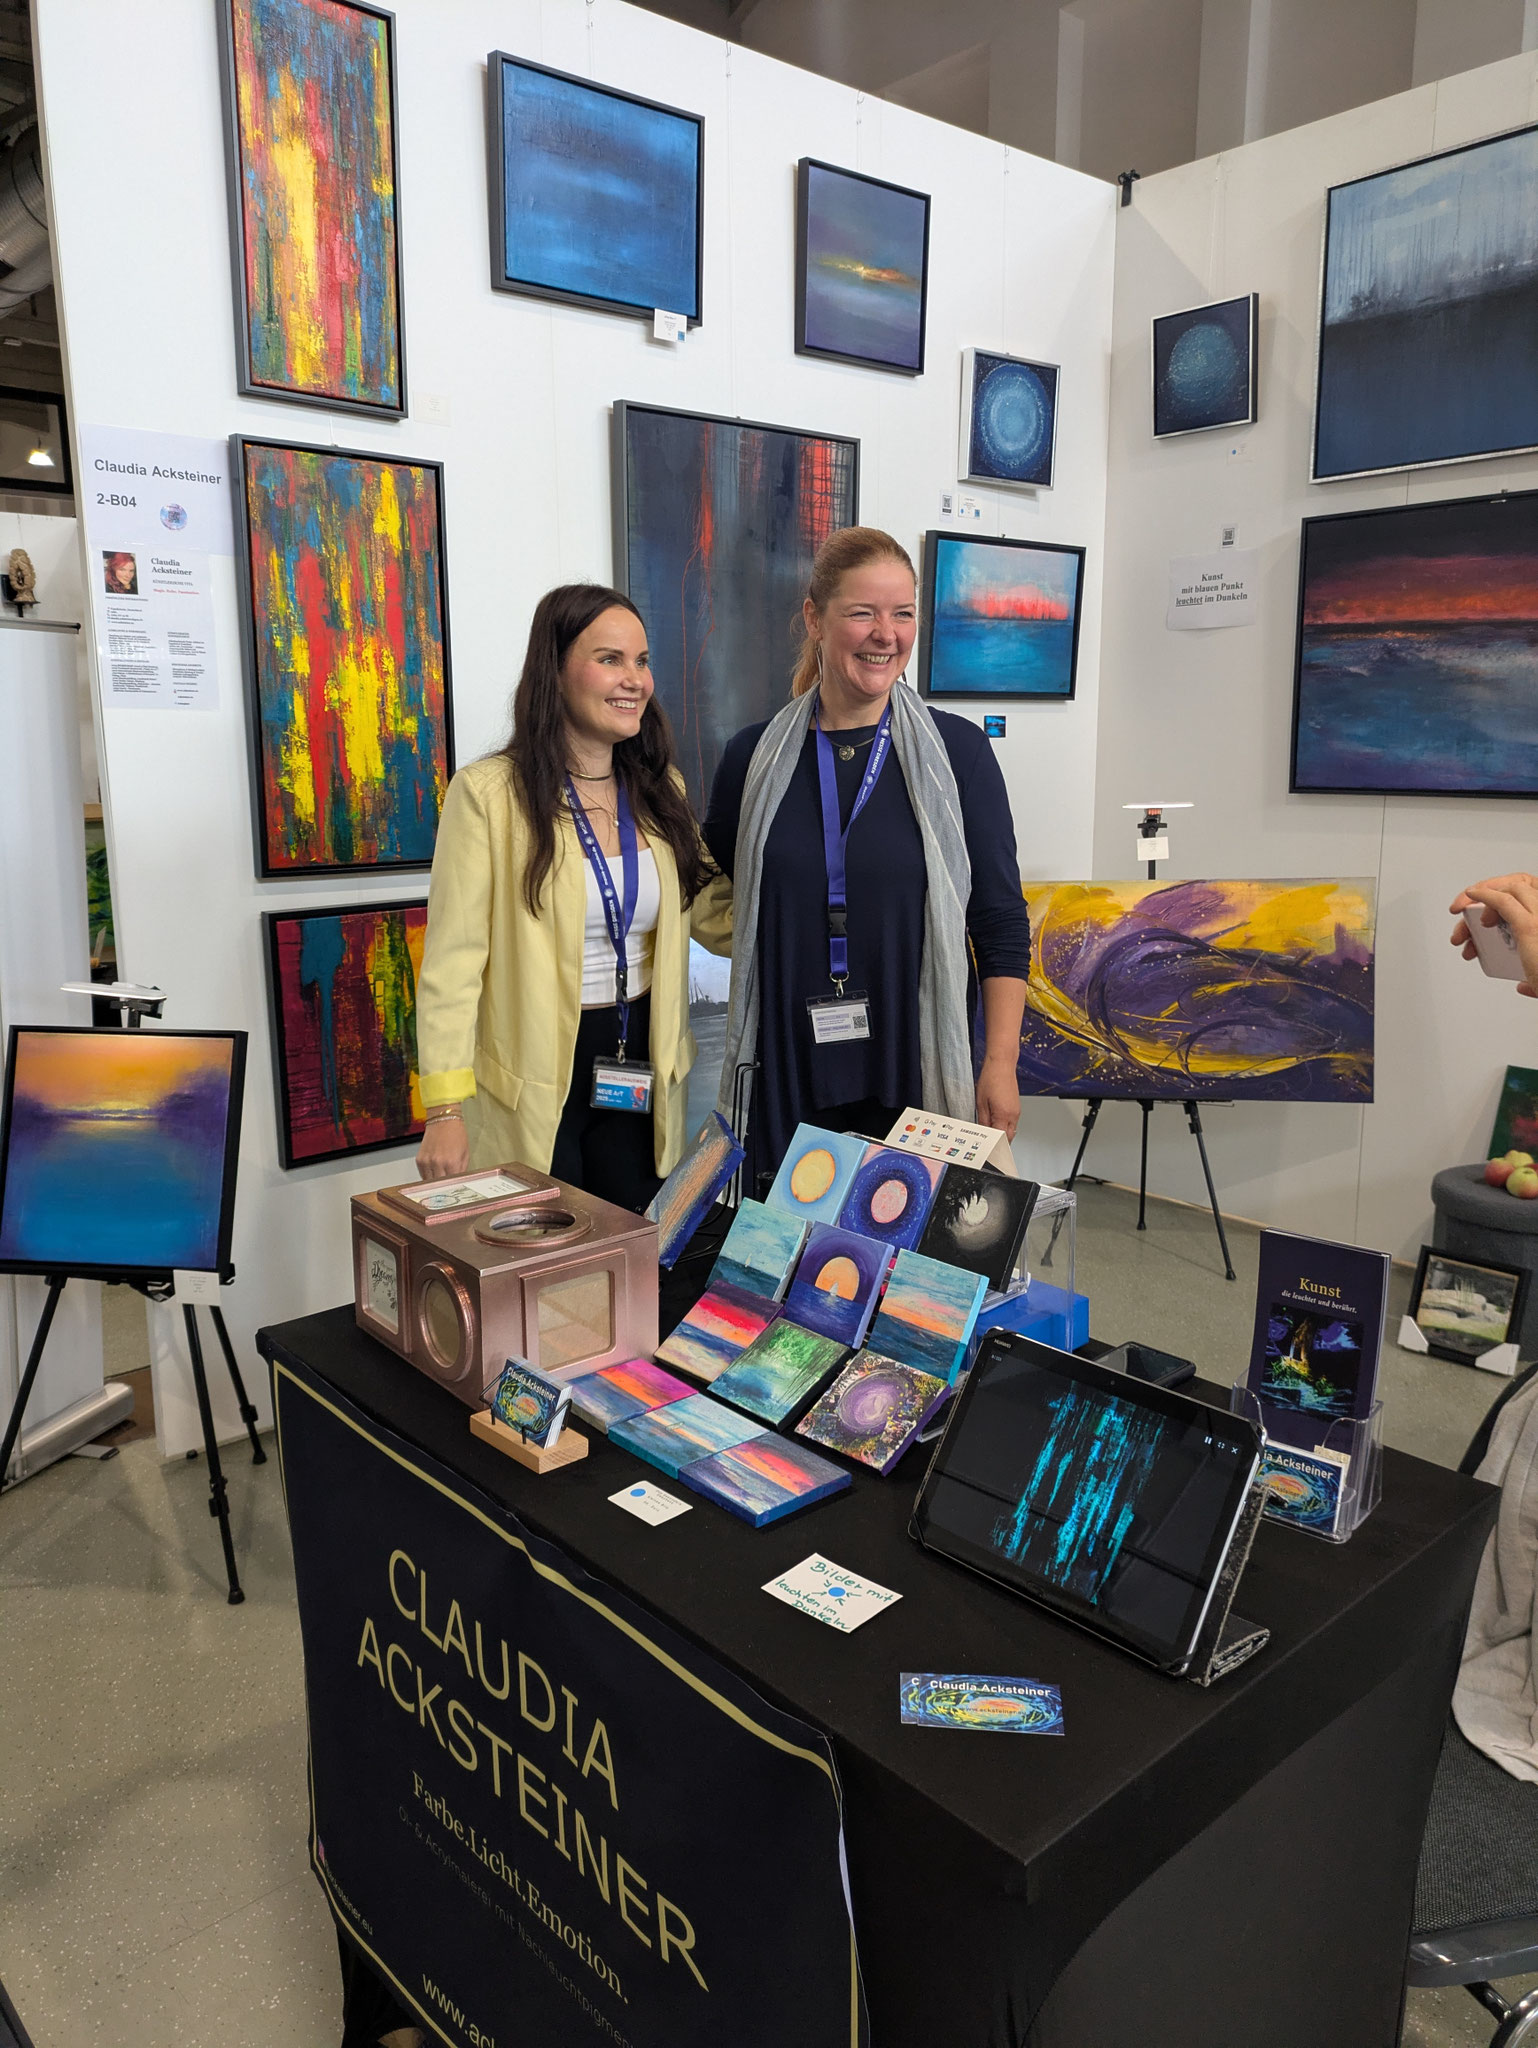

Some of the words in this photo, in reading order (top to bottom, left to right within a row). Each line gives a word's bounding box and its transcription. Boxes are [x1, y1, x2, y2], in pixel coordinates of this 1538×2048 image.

[94, 458, 147, 476] Claudia
[152, 465, 222, 485] Acksteiner
[96, 492, 137, 508] 2-B04
[151, 557, 181, 567] Claudia
[151, 566, 192, 576] Acksteiner
[1181, 586, 1194, 594] mit
[1194, 585, 1218, 593] blauen
[1221, 581, 1243, 591] Punkt
[1201, 573, 1223, 582] Kunst
[1175, 596, 1203, 606] leuchtet
[1204, 595, 1214, 603] im
[1215, 592, 1248, 602] Dunkeln
[937, 1132, 949, 1140] VISA
[954, 1137, 967, 1145] VISA
[1299, 1277, 1341, 1298] Kunst
[1281, 1290, 1291, 1298] die
[1292, 1292, 1316, 1304] leuchtet
[1317, 1298, 1330, 1308] und
[1331, 1301, 1357, 1314] berührt.
[507, 1366, 527, 1385] Claudia
[526, 1378, 556, 1401] Acksteiner
[1273, 1454, 1334, 1480] Acksteiner
[809, 1560, 863, 1589] Bilder
[866, 1588, 894, 1603] mit
[775, 1578, 821, 1608] leuchten
[823, 1604, 838, 1616] im
[791, 1599, 851, 1630] Dunkeln
[388, 1549, 619, 1812] CLAUDIA
[930, 1680, 977, 1692] Claudia
[981, 1683, 1051, 1697] Acksteiner
[357, 1616, 710, 1993] ACKSTEINER
[412, 1770, 628, 2005] Farbe.Licht.Emotion.
[425, 1833, 492, 1909] Acrylmalerei
[494, 1904, 515, 1930] mit
